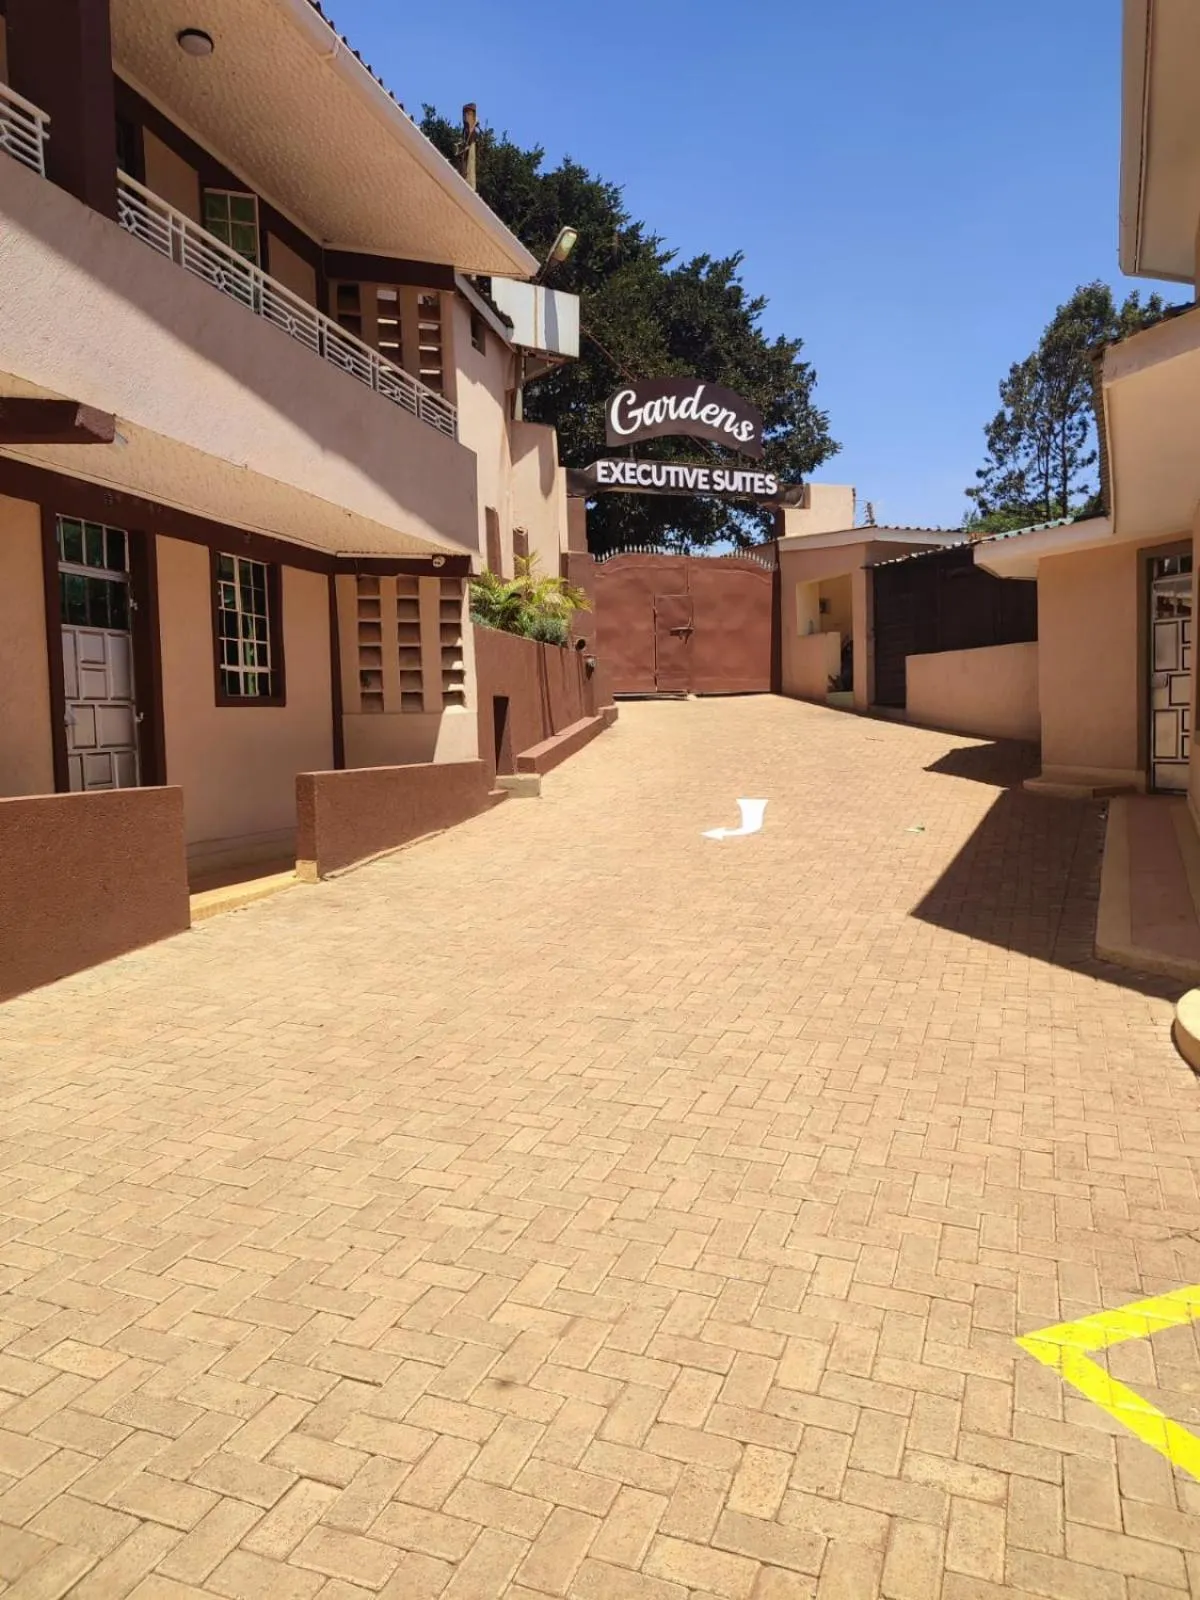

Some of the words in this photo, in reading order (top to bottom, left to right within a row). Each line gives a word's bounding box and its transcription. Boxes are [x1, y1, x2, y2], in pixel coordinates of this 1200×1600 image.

[610, 384, 755, 441] Gardens
[596, 460, 711, 490] EXECUTIVE
[712, 469, 778, 495] SUITES
